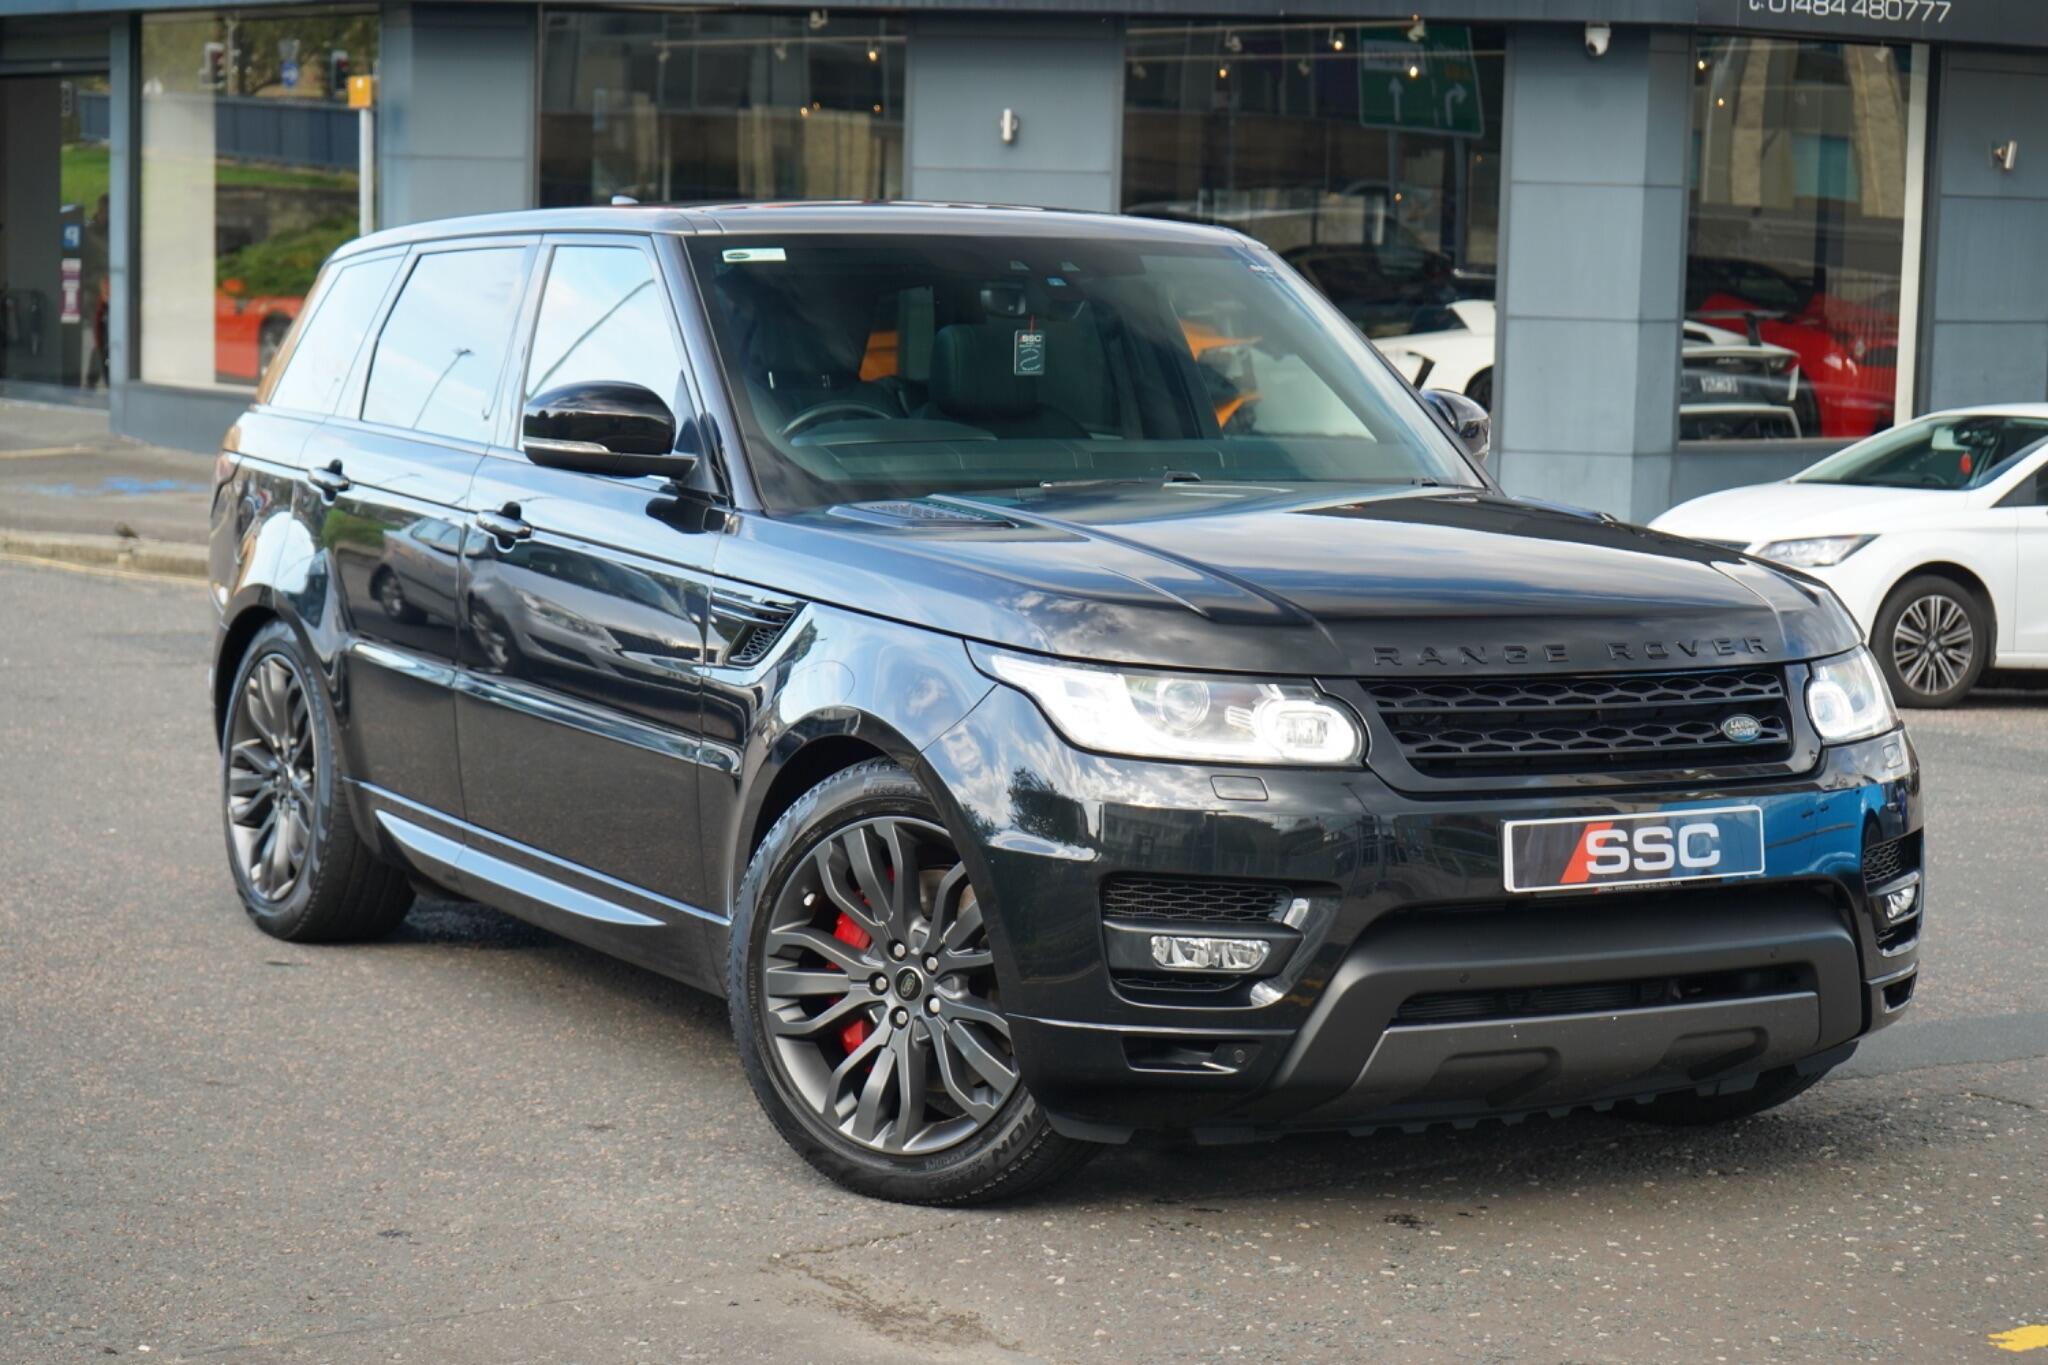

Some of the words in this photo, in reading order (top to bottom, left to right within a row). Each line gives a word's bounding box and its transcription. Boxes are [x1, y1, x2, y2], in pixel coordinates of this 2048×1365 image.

[1851, 0, 1952, 23] 480777
[1373, 644, 1570, 666] RANGE
[1606, 637, 1769, 660] ROVER
[1585, 822, 1721, 875] SSC
